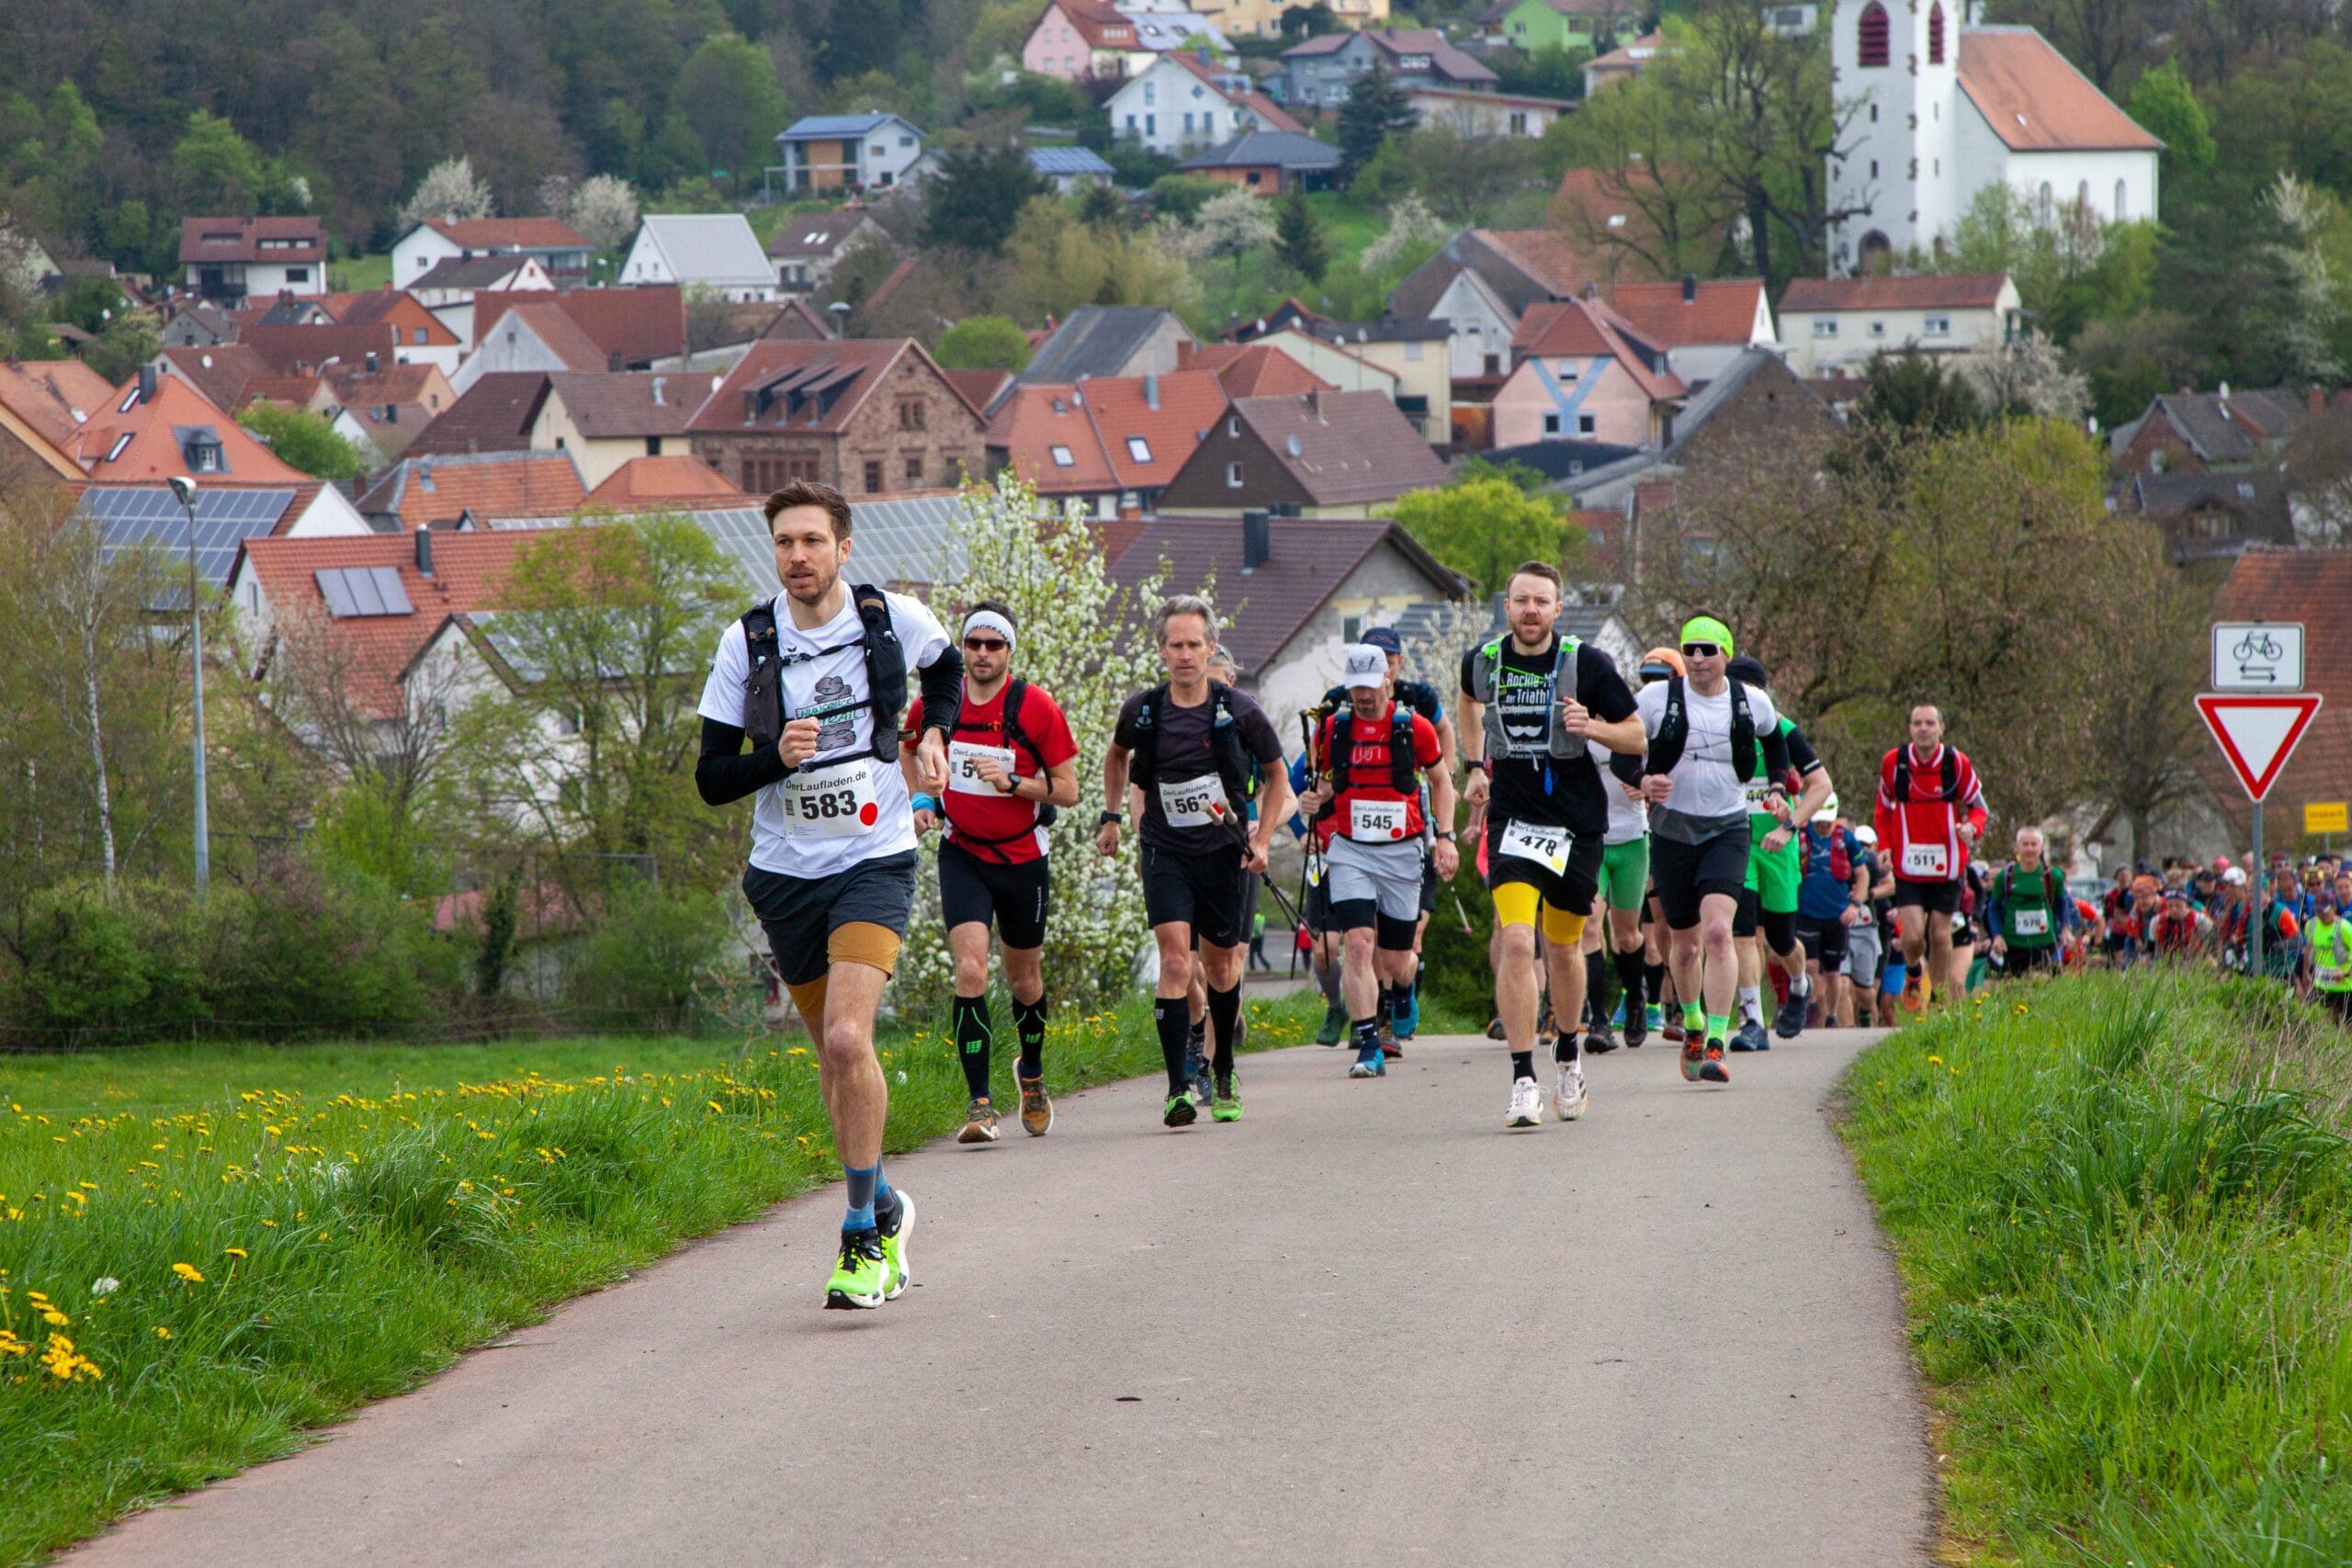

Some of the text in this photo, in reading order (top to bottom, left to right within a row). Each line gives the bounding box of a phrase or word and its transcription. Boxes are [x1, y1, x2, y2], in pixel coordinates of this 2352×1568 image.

[785, 771, 867, 792] DerLaufladen.de
[799, 789, 858, 820] 583
[1362, 814, 1393, 829] 545
[1519, 835, 1557, 858] 478
[1914, 854, 1936, 866] 511
